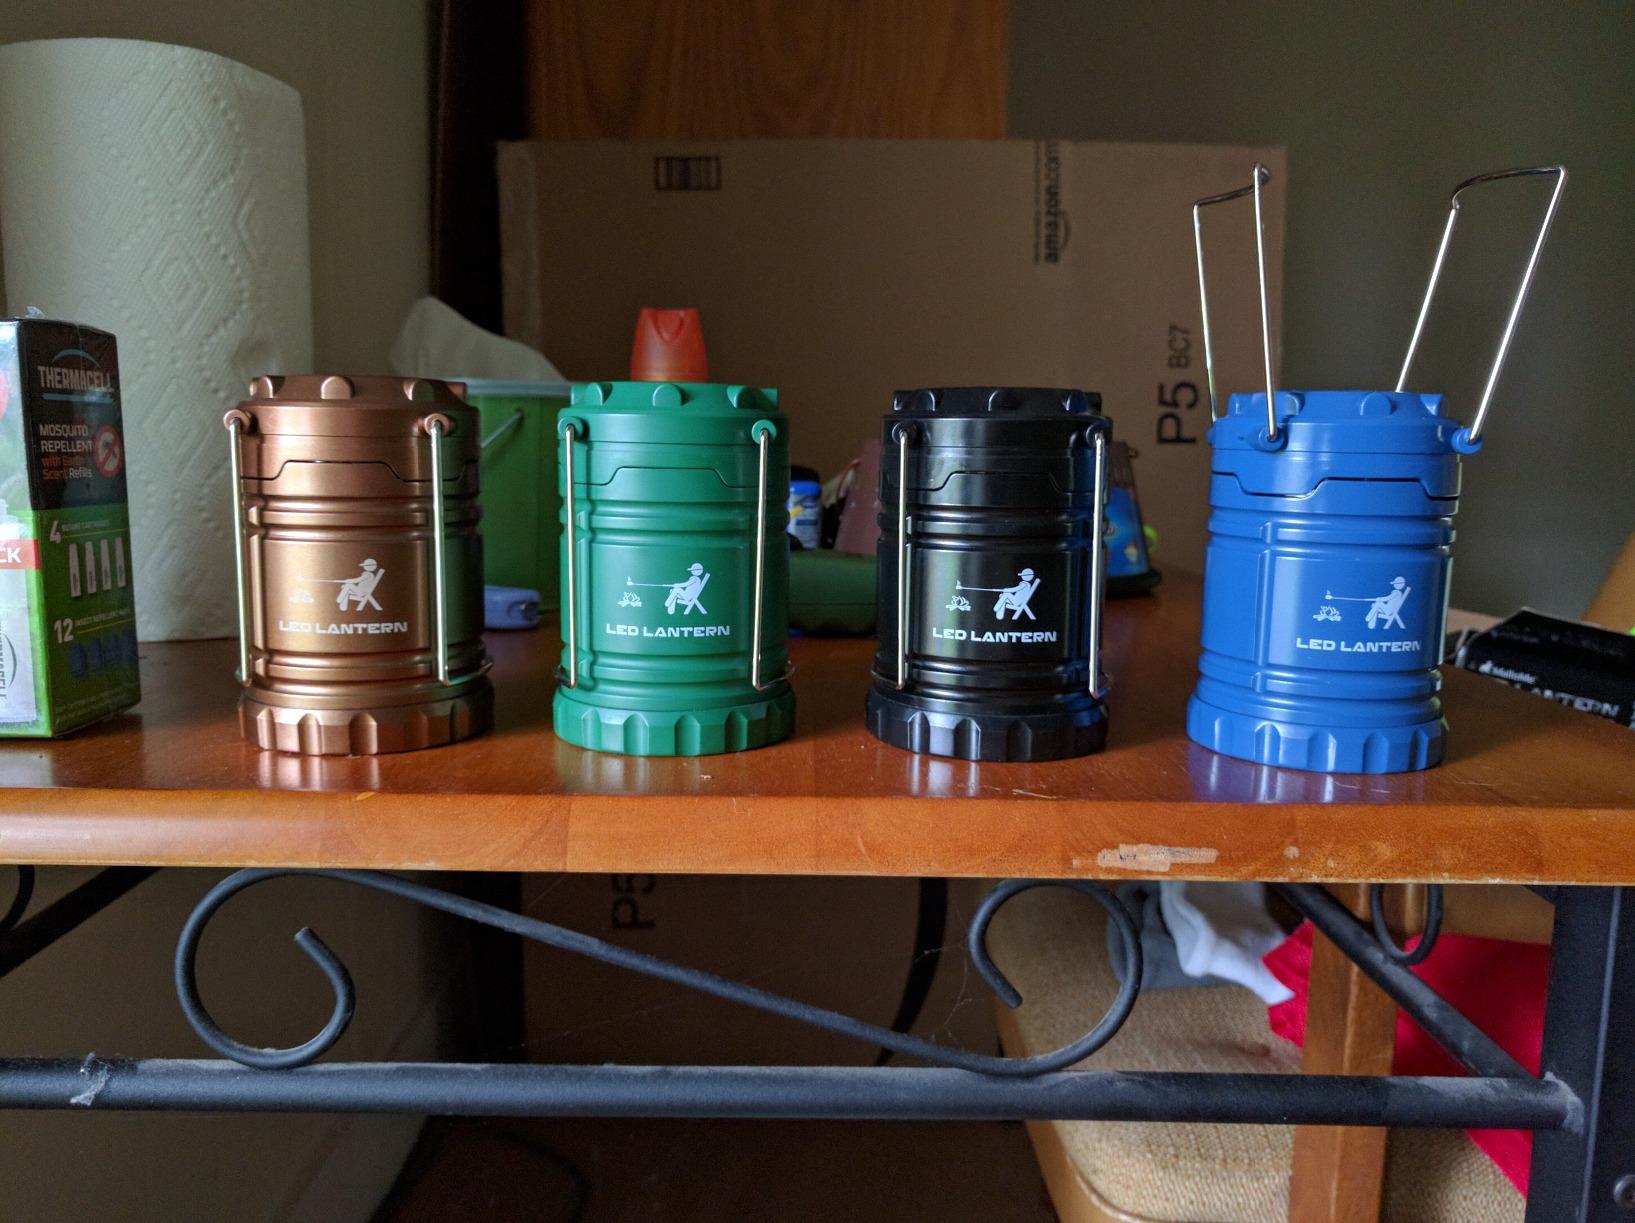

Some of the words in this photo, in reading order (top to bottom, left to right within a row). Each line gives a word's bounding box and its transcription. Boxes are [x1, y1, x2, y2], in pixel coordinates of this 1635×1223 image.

[1168, 324, 1191, 369] BC7
[37, 365, 114, 392] THERMACELL
[1157, 382, 1199, 445] P5
[39, 424, 89, 438] MOSQUITO
[40, 440, 94, 453] REPELLENT
[50, 520, 62, 544] 4
[53, 617, 74, 643] 12
[279, 620, 311, 633] LED
[315, 621, 408, 634] LANTERN
[606, 623, 639, 636] LED
[643, 625, 731, 637] LANTERN
[932, 627, 967, 640] LED
[970, 630, 1057, 643] LANTERN
[1296, 637, 1335, 650] LED
[1340, 640, 1422, 653] LANTERN
